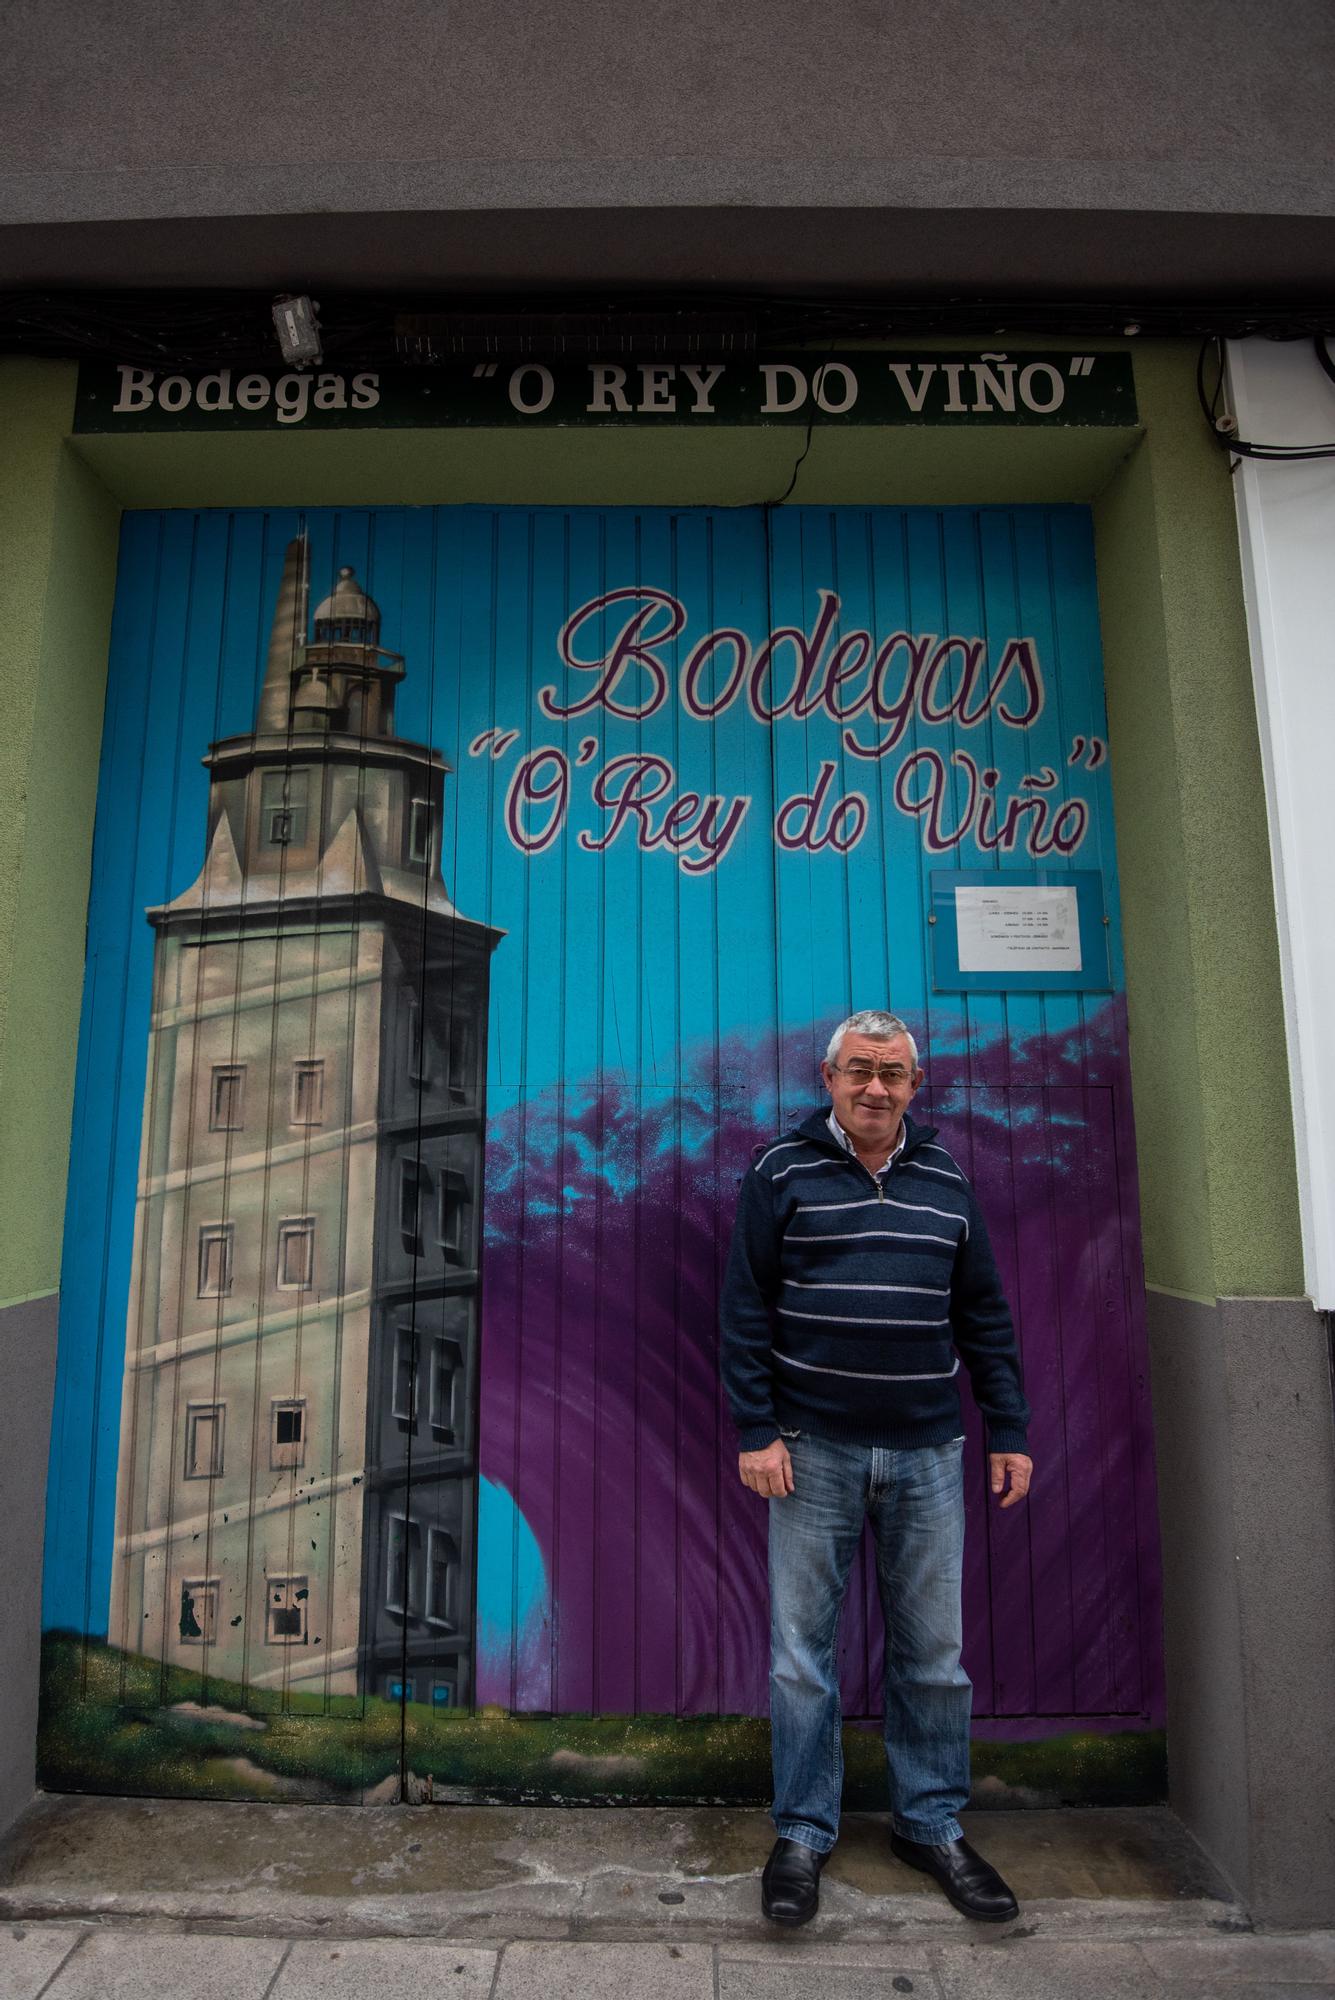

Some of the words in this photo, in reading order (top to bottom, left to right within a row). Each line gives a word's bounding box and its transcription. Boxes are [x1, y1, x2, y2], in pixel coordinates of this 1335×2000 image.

[112, 364, 381, 423] Bodegas
[586, 363, 726, 413] REY
[759, 362, 859, 414] DO
[889, 353, 1096, 413] VIÑO"
[538, 584, 1049, 760] Bodegas
[774, 760, 868, 853] do
